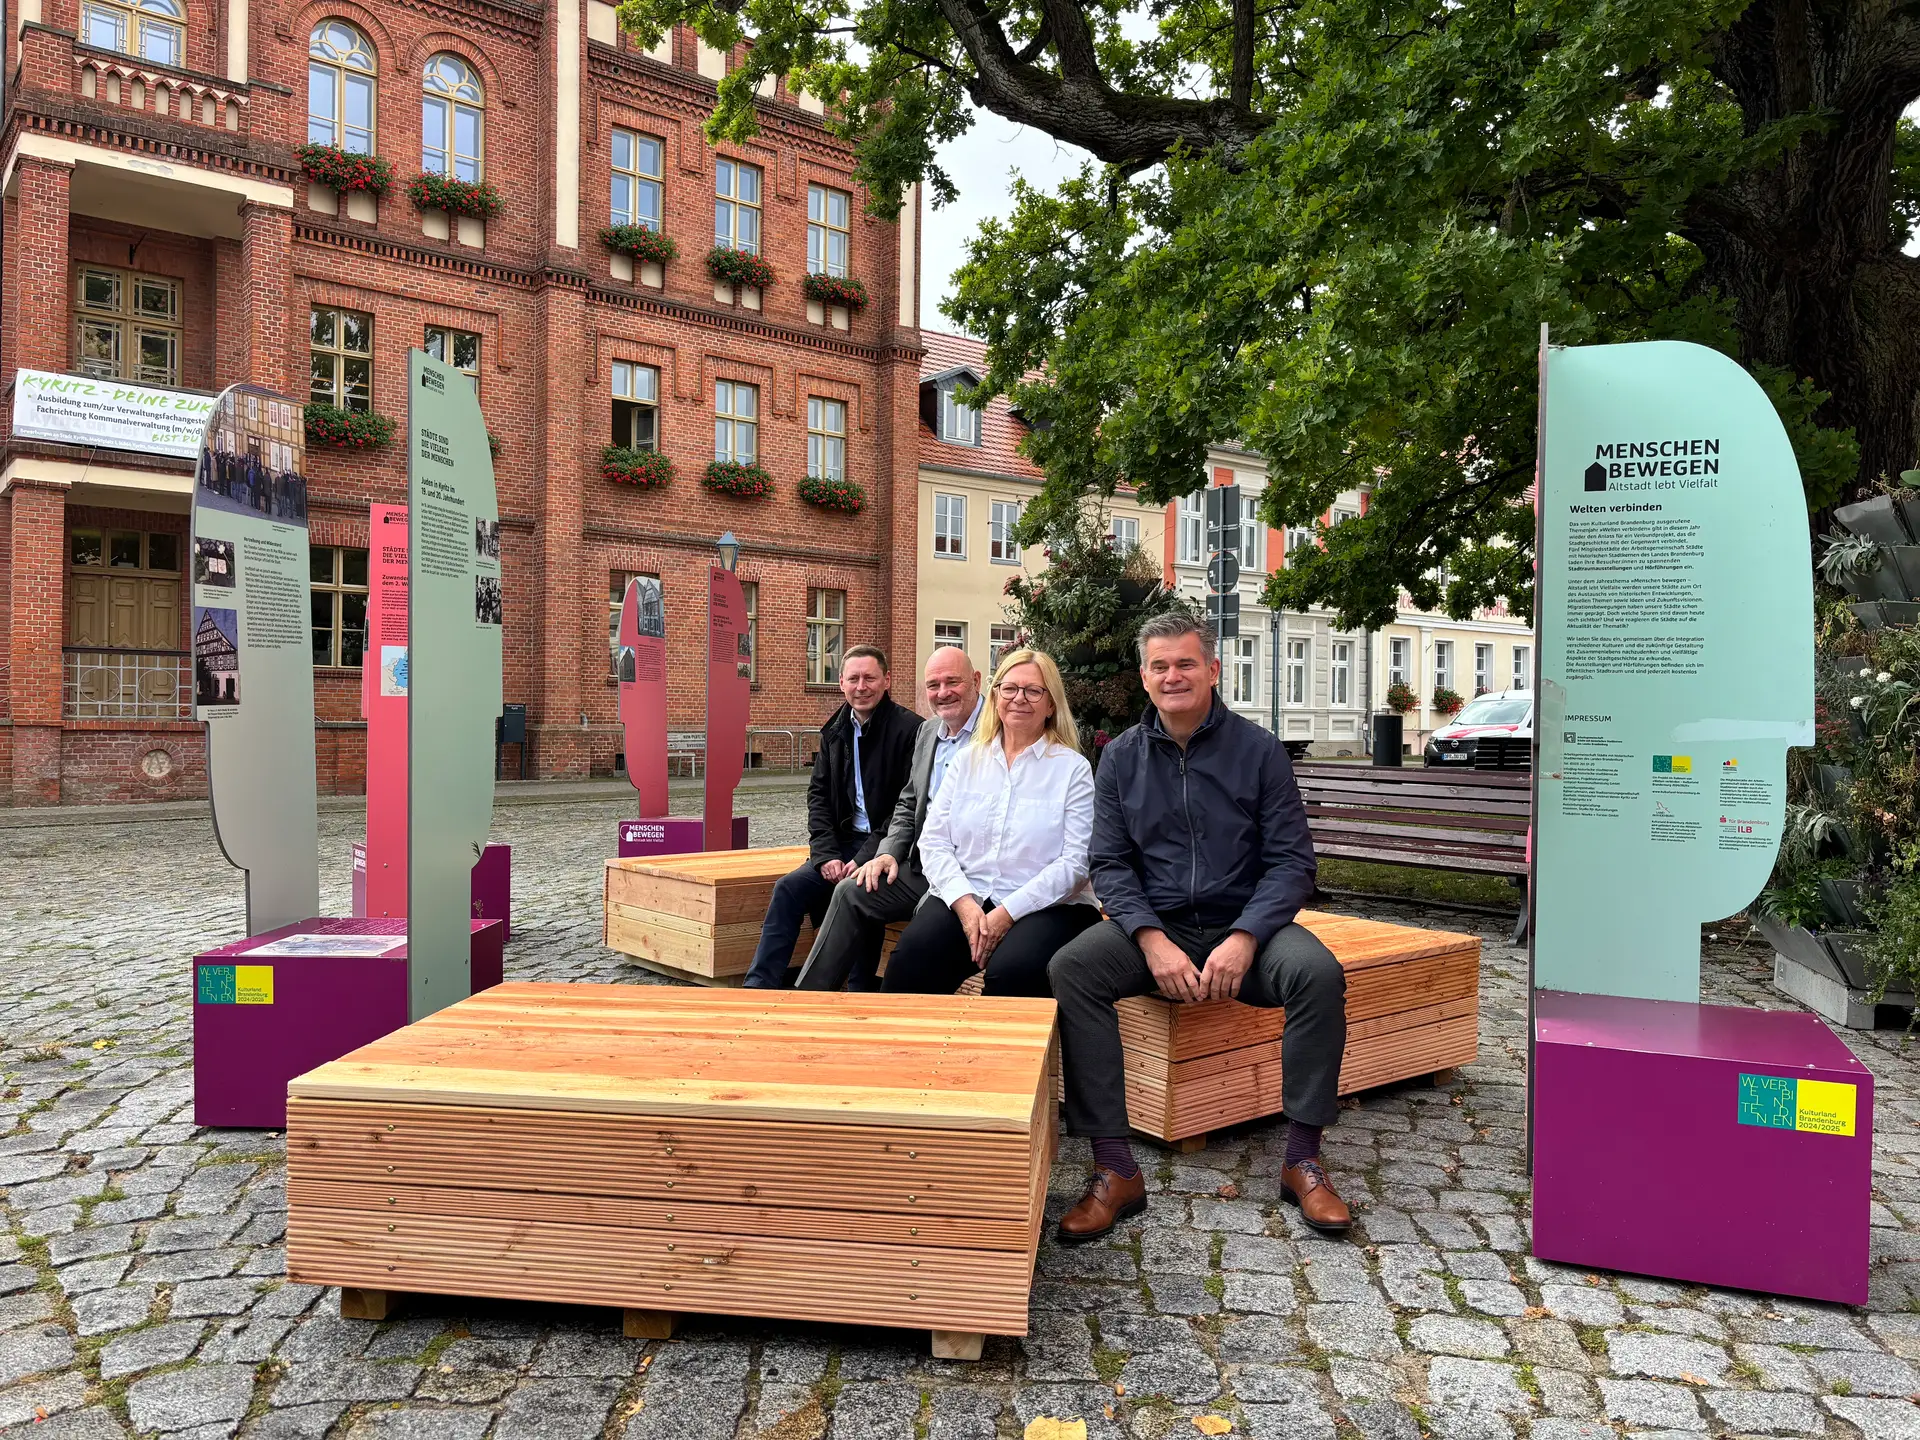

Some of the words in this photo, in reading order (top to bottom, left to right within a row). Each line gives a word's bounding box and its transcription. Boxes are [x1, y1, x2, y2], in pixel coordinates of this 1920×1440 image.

[22, 374, 98, 396] KYRITZ
[113, 388, 168, 408] DEINE
[174, 398, 212, 413] ZUK
[37, 394, 82, 408] Ausbildung
[83, 402, 115, 412] zum/zur
[116, 406, 208, 424] Verwaltungsfachangeste
[37, 405, 86, 420] Fachrichtung
[88, 412, 170, 432] Kommunalverwaltung
[172, 425, 203, 436] (m/w/d)
[152, 434, 179, 442] BIST
[1596, 439, 1719, 460] MENSCHEN
[1609, 459, 1719, 478] BEWEGEN
[1608, 481, 1652, 491] Altstadt
[1655, 480, 1676, 490] lebt
[1679, 478, 1718, 489] Vielfalt
[1570, 504, 1606, 513] Welten
[1610, 503, 1662, 513] verbinden
[1800, 1108, 1837, 1118] Kulturland
[1799, 1116, 1846, 1127] Brandenburg
[1799, 1122, 1840, 1132] 2024/2025
